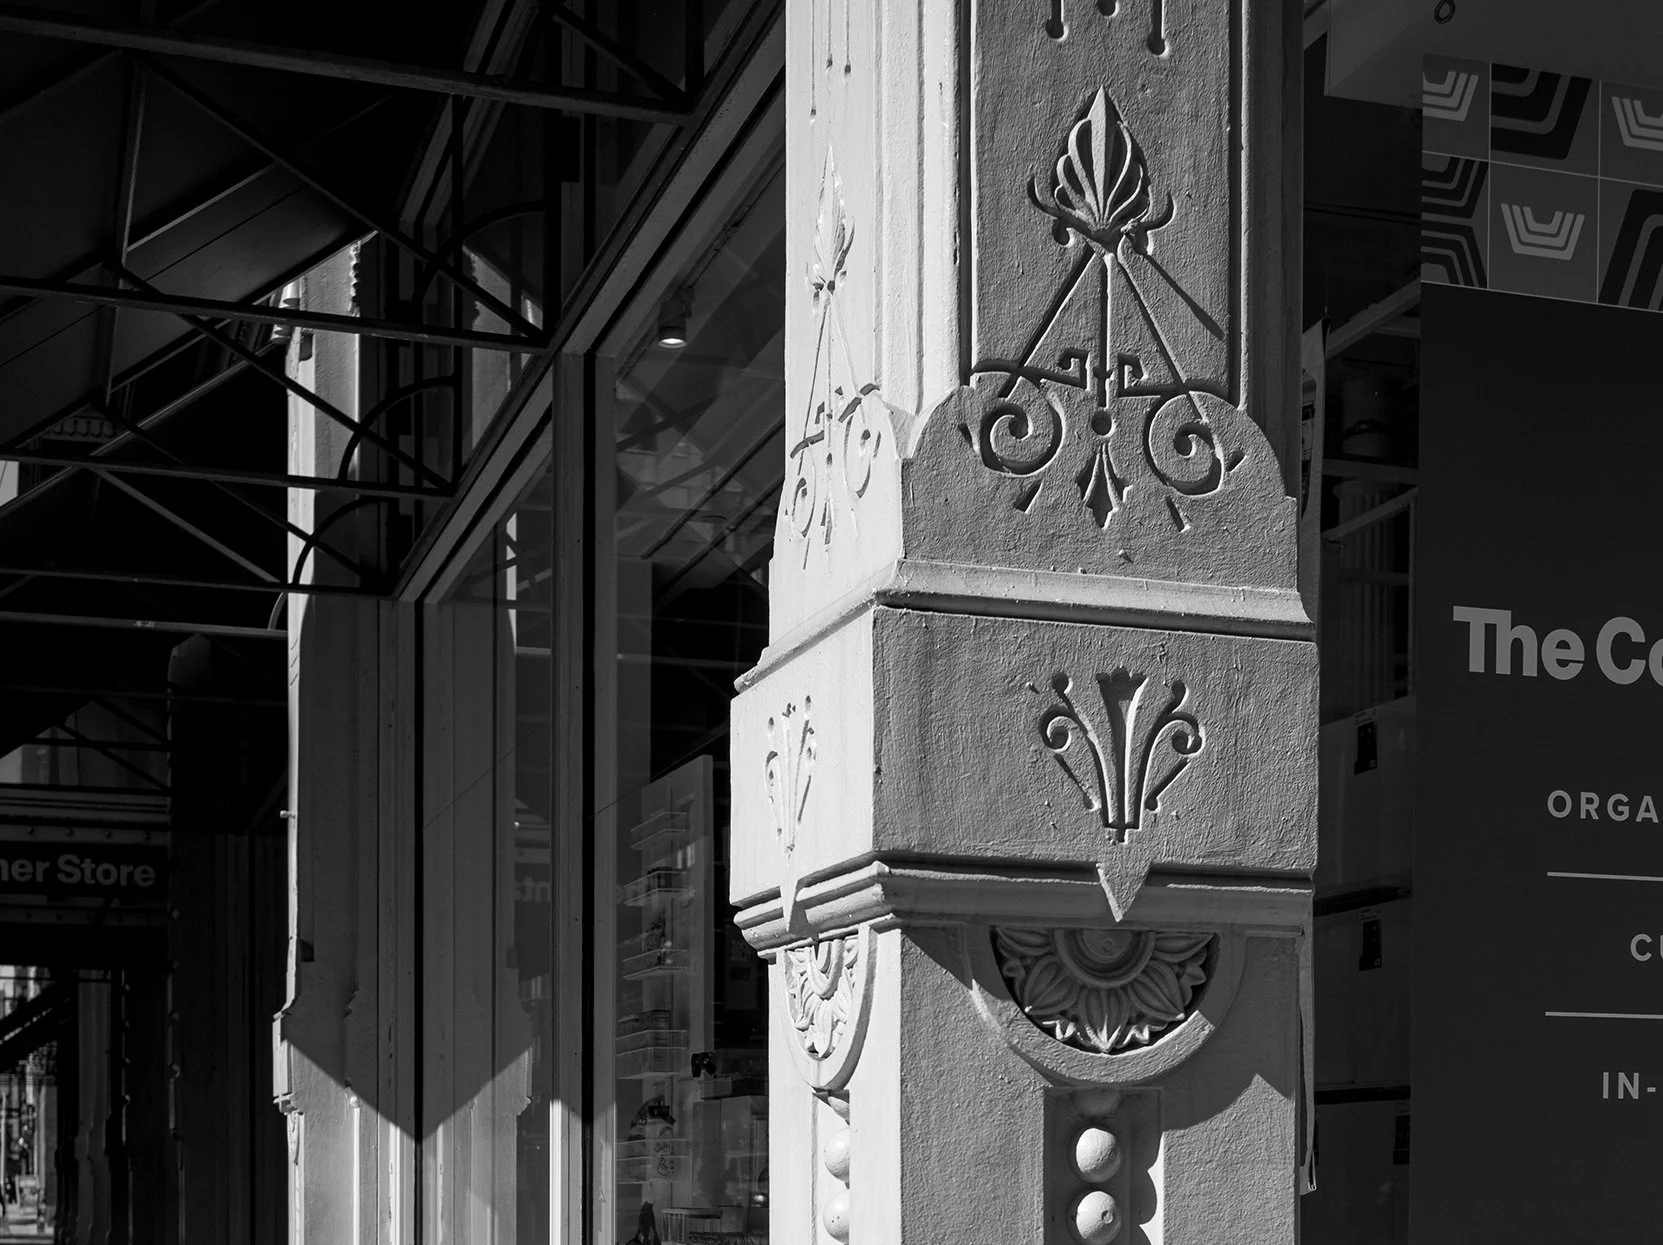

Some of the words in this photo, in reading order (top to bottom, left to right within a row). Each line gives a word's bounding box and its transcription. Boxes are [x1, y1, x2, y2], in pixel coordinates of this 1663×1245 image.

[1453, 605, 1585, 681] The
[1547, 789, 1660, 824] ORGA
[56, 853, 156, 888] Store
[1630, 933, 1663, 962] C
[1602, 1071, 1657, 1100] IN-
